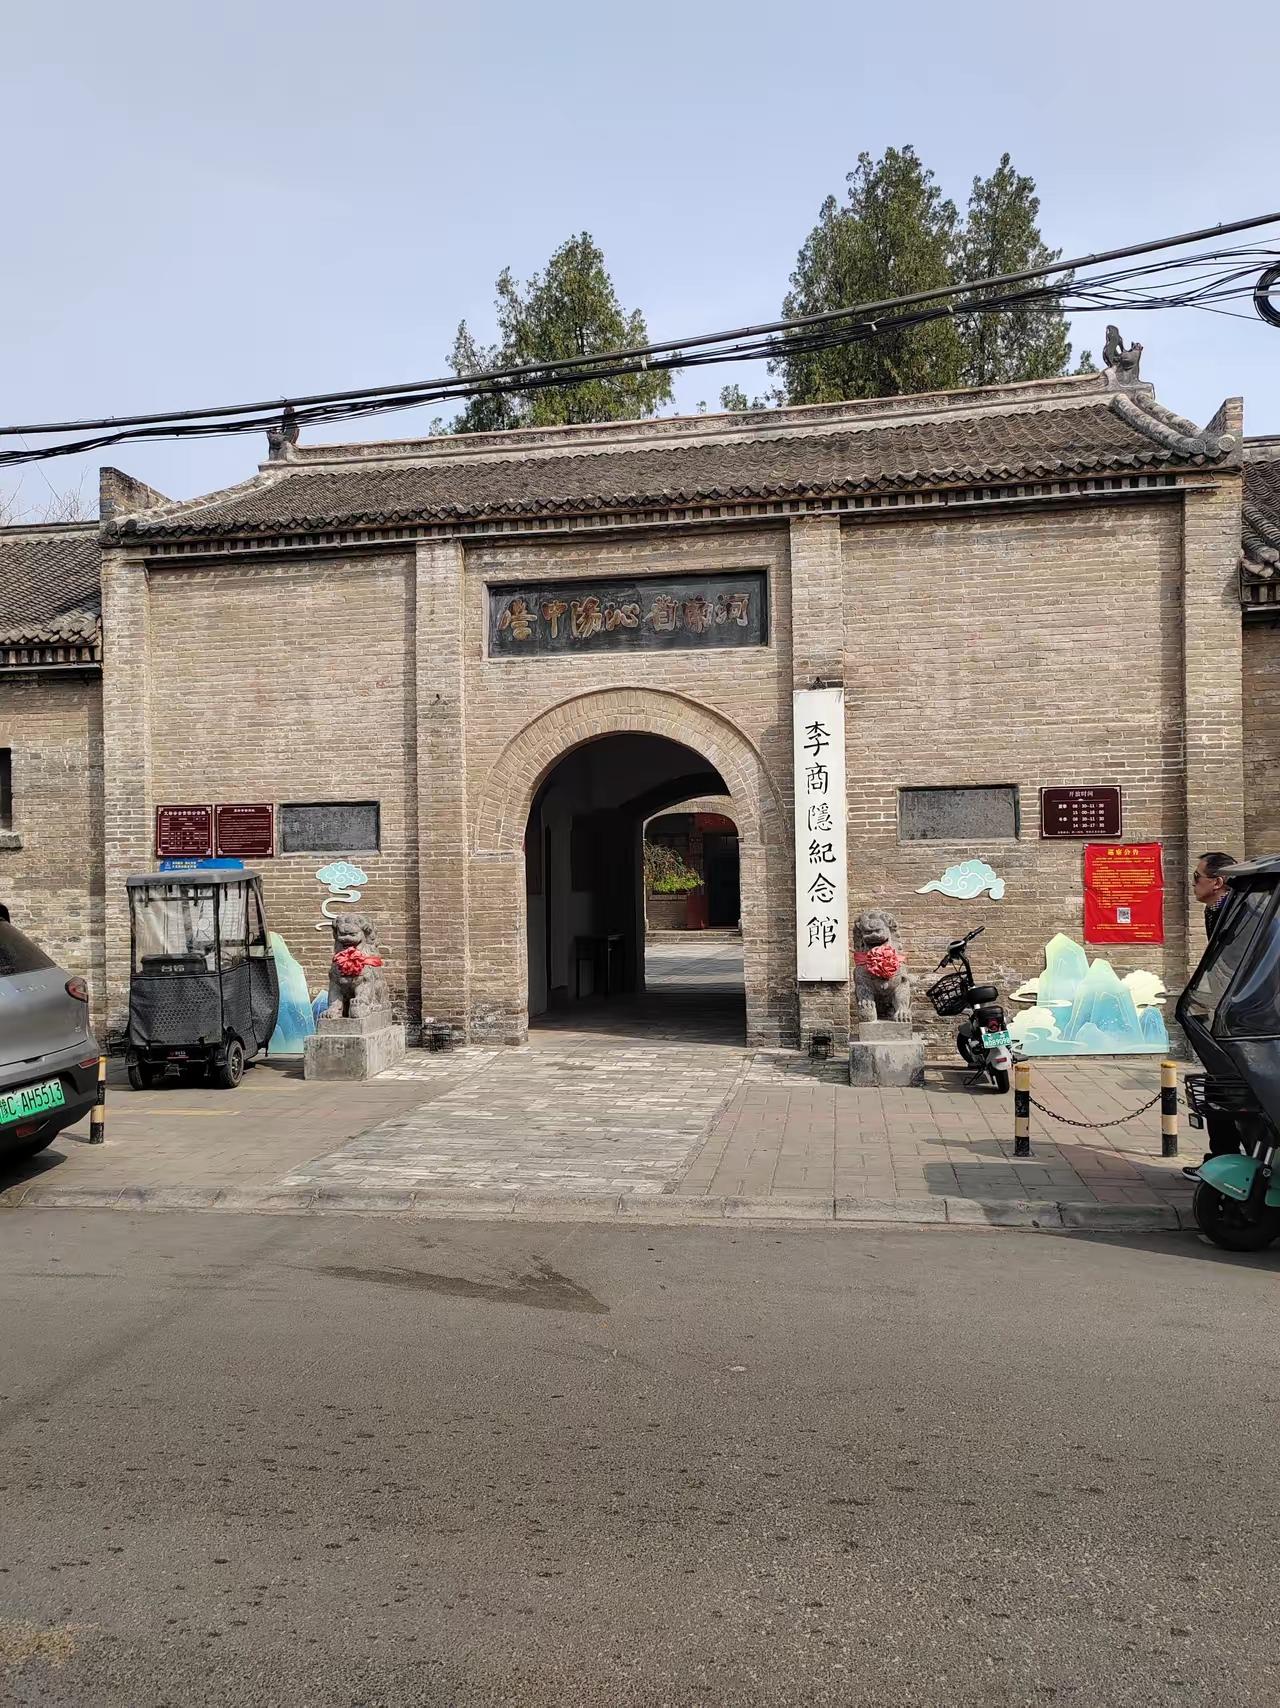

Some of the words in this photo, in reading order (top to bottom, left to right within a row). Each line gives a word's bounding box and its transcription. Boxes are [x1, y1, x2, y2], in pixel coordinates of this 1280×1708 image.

[802, 720, 839, 951] 李商隱紀念館
